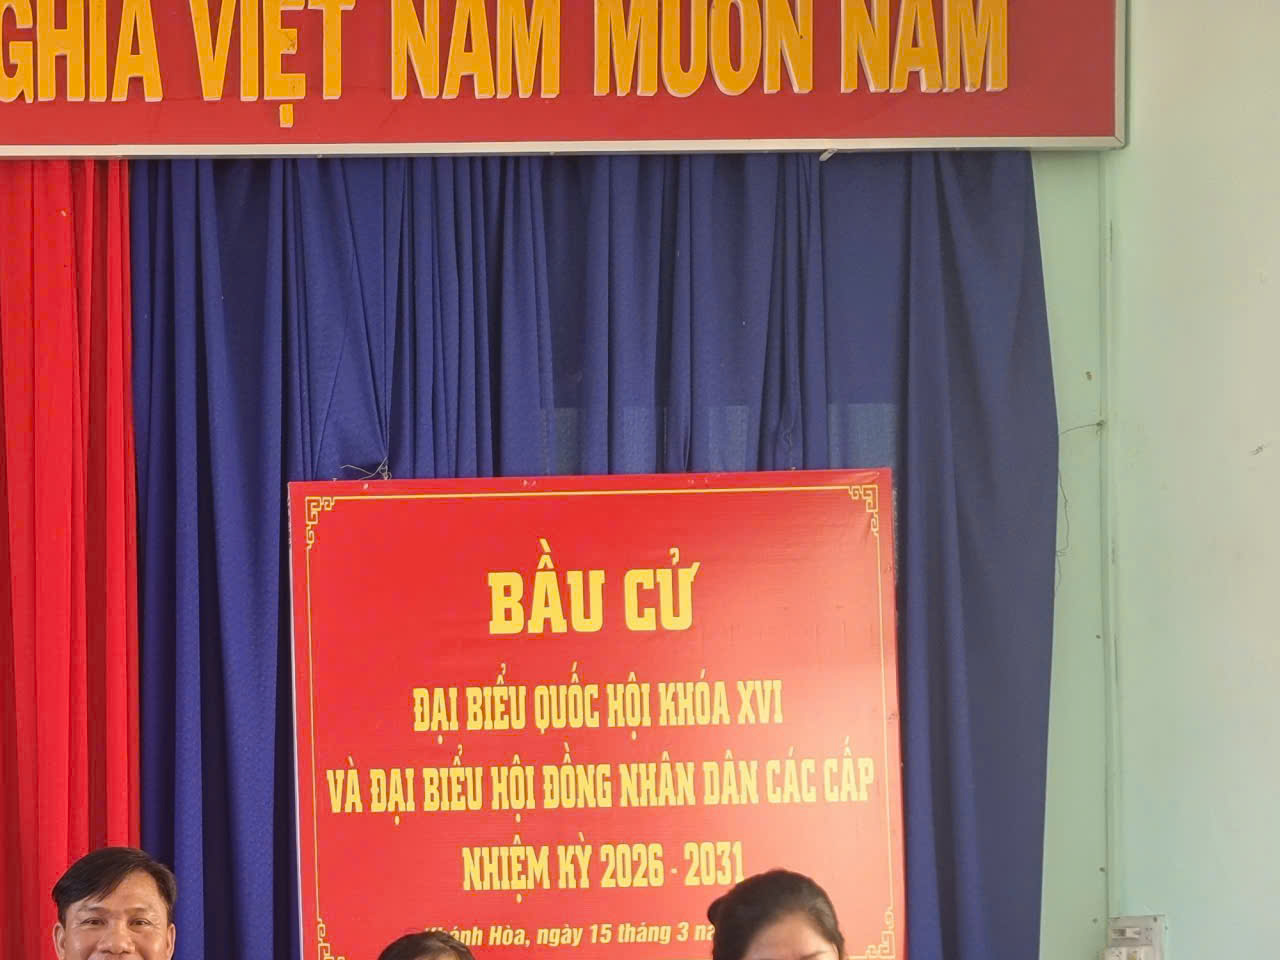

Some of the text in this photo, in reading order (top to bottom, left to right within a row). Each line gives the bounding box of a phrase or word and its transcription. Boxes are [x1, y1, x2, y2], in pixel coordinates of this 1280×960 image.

[391, 0, 560, 100] NAM
[487, 539, 700, 634] BẦU CỬ
[413, 661, 783, 744] ĐẠI BIỂU QUỐC HỘI KHÓA XVI
[327, 737, 875, 825] VÀ ĐẠI BIỂU HỘI ĐỒNG NHÂN DÂN CÁC CẤP
[462, 834, 550, 903] NHIỆM
[557, 832, 592, 889] KỲ
[600, 843, 664, 888] 2026
[683, 841, 745, 886] 2031
[488, 925, 530, 947] Hòa,
[537, 923, 583, 947] ngày
[590, 924, 612, 943] 15
[618, 922, 671, 945] tháng
[676, 922, 688, 941] 3
